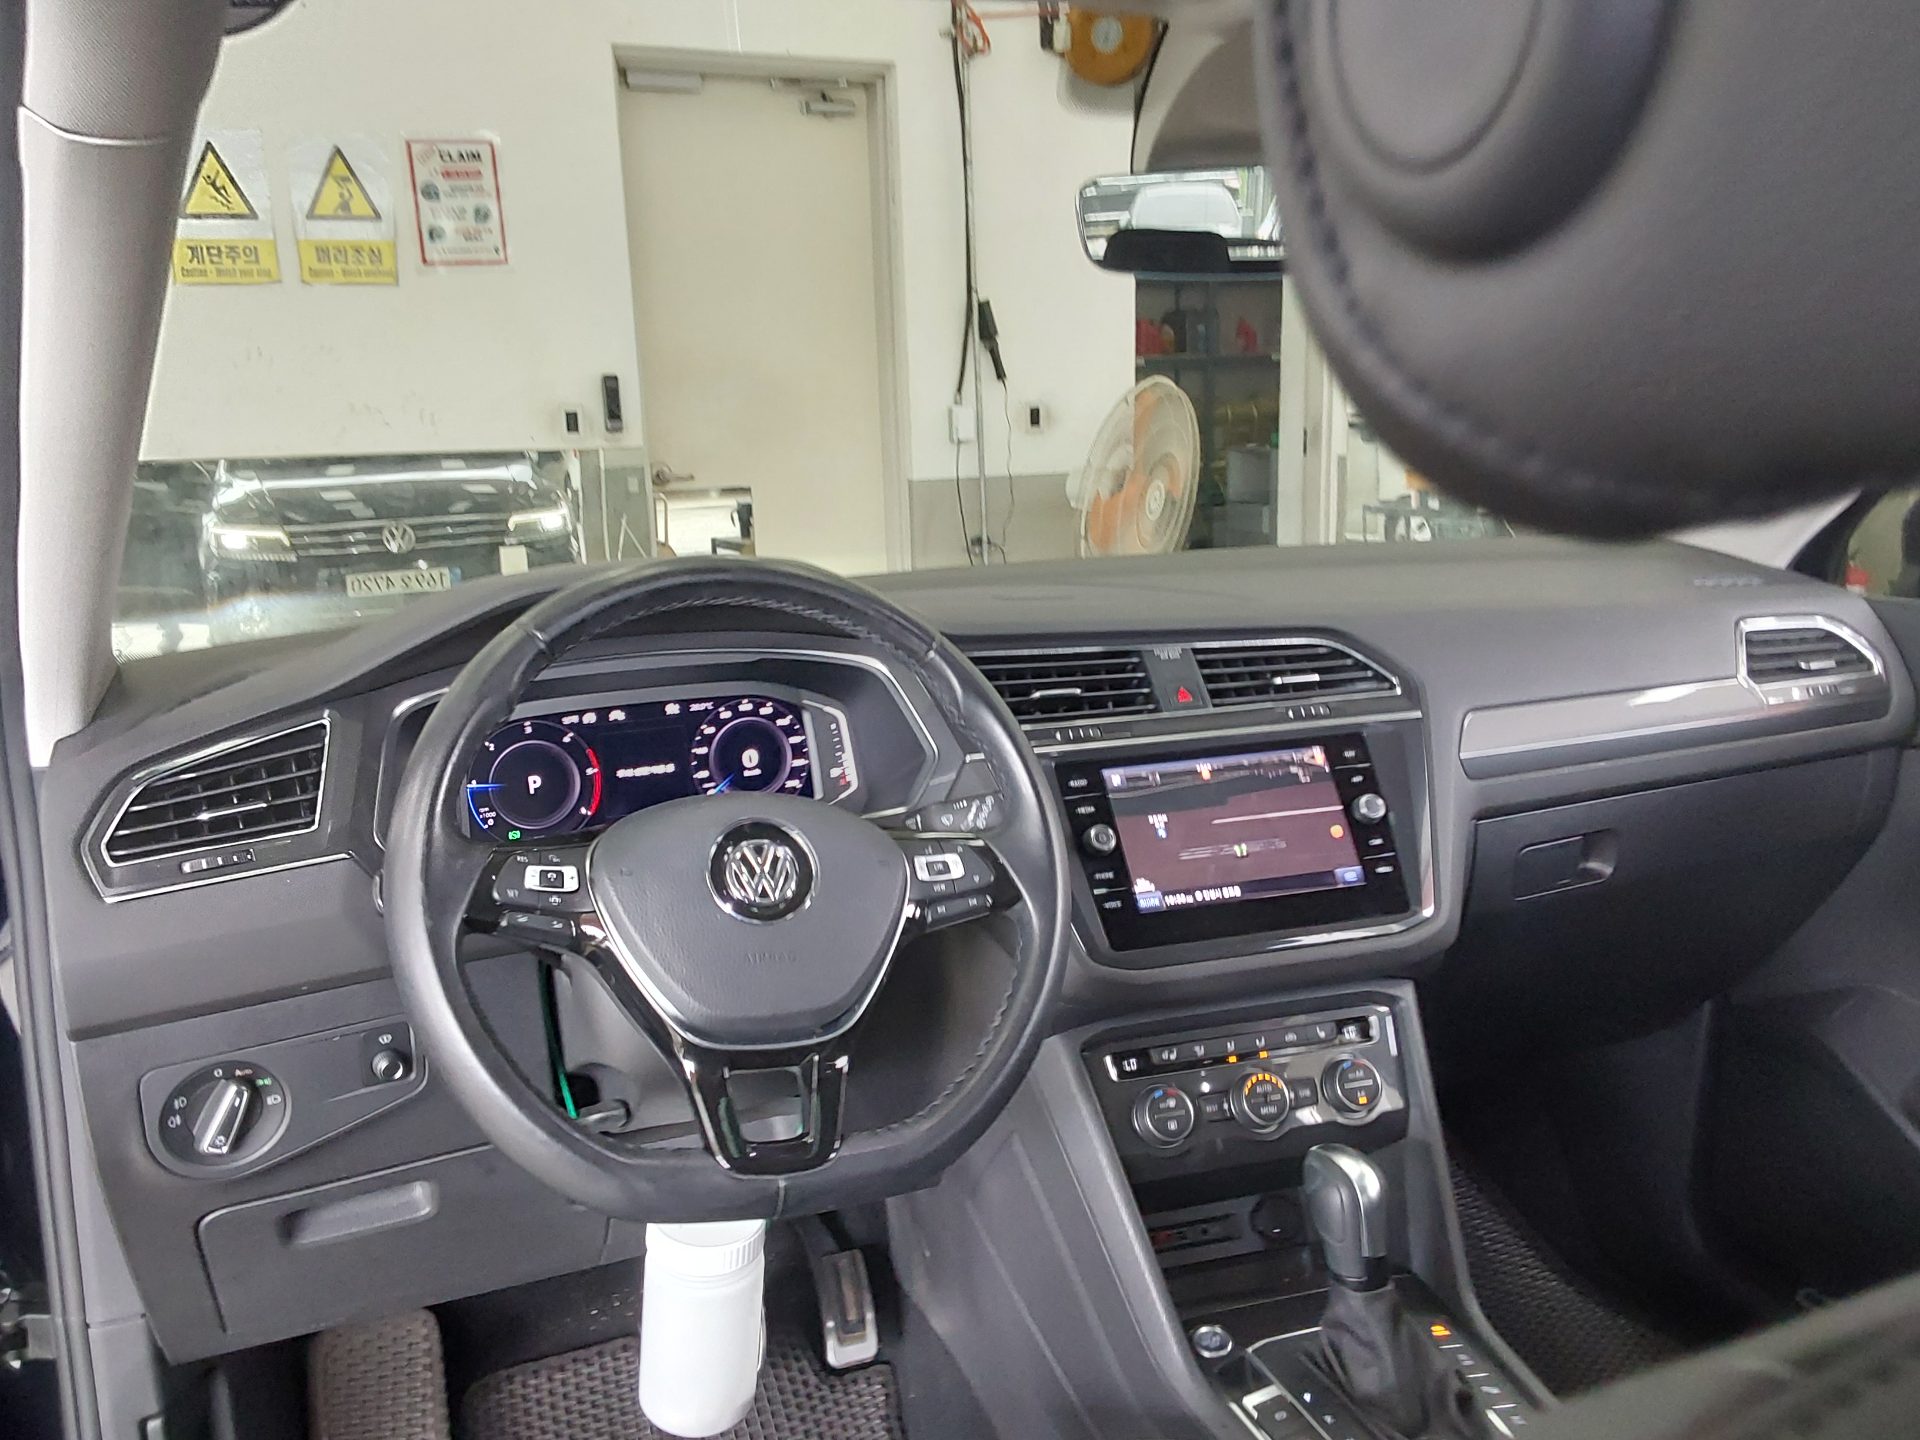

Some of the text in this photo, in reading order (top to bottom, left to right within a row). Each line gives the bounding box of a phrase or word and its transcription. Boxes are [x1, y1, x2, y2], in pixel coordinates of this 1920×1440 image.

[438, 149, 482, 163] CLAIM
[186, 244, 260, 265] 계단주의
[527, 774, 542, 795] P
